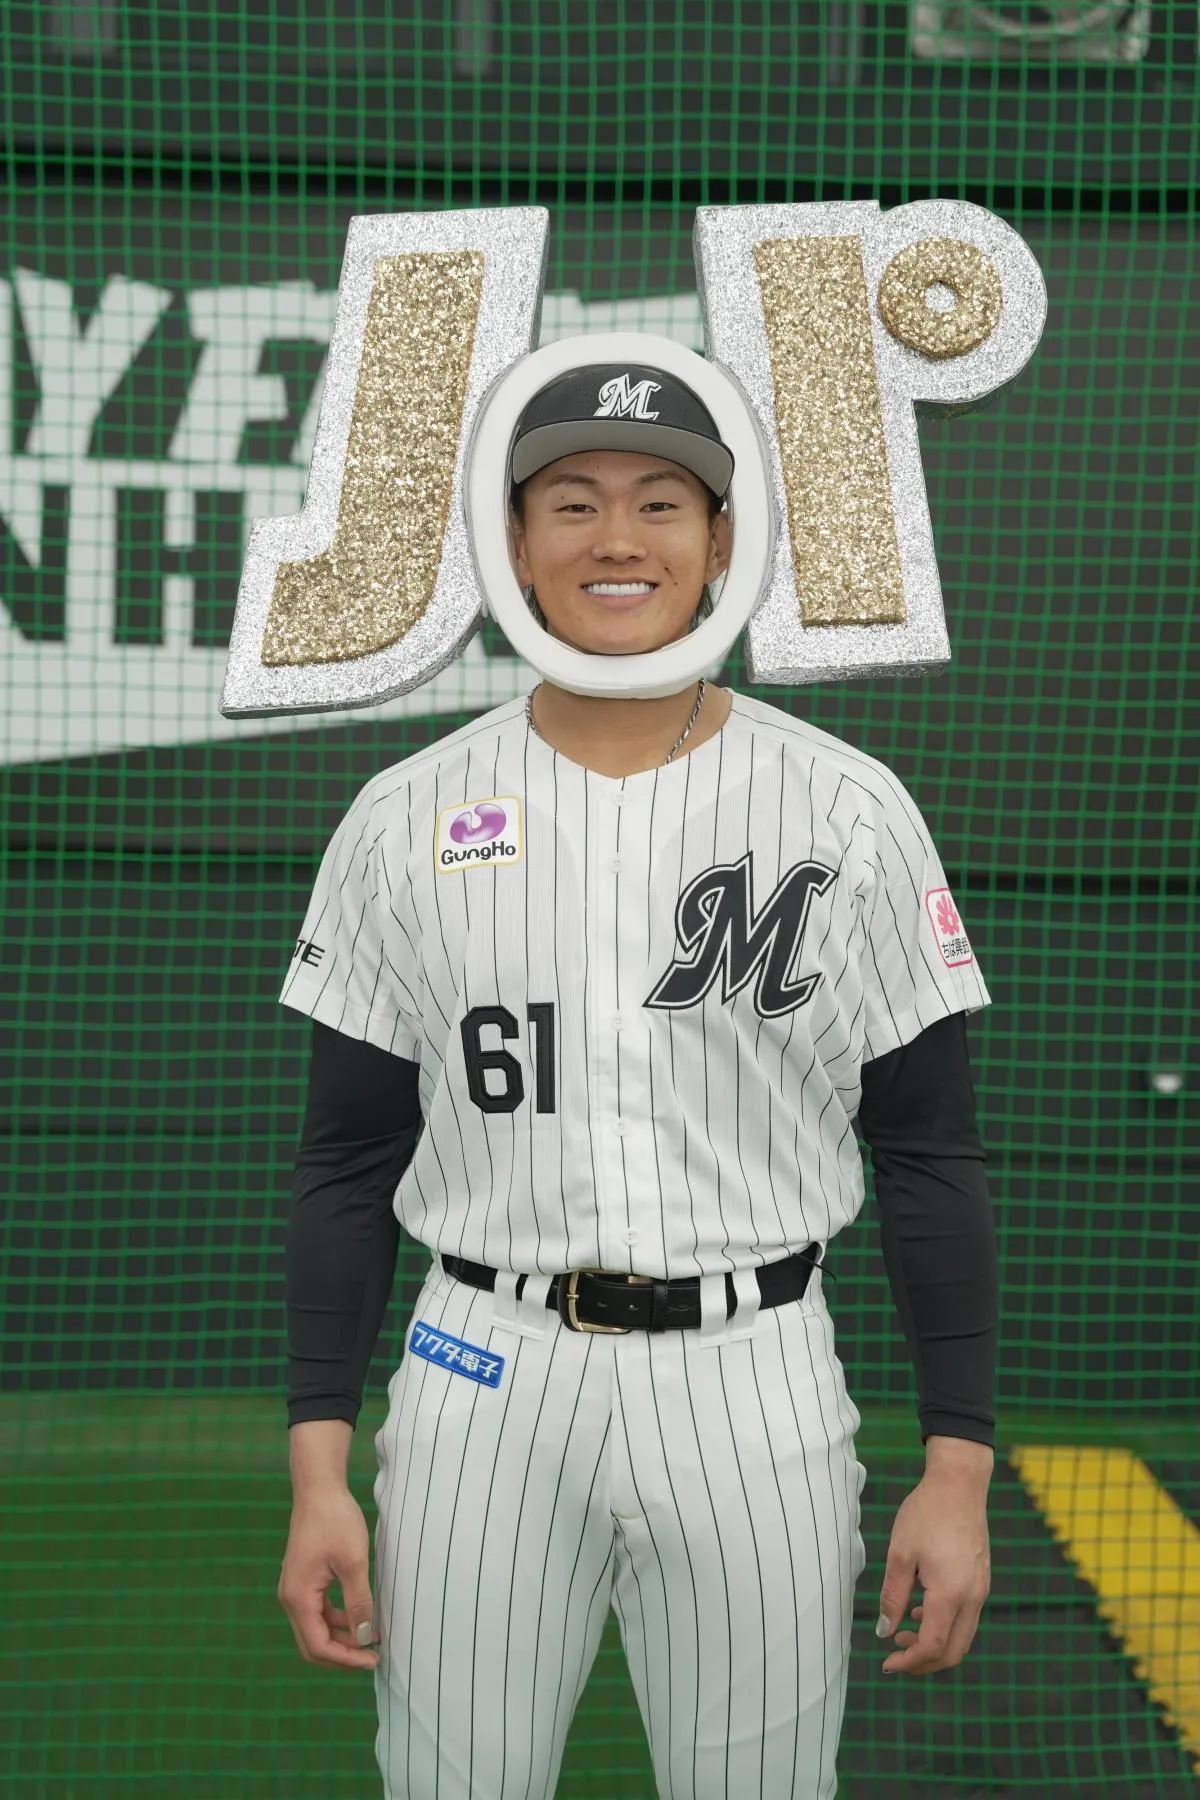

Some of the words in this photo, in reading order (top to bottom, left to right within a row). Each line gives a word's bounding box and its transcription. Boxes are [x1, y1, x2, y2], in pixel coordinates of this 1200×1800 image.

[593, 373, 662, 420] M
[441, 841, 516, 865] GungHo
[642, 850, 839, 1019] M
[460, 1002, 556, 1114] 61
[414, 1326, 500, 1379] フクダ電子
